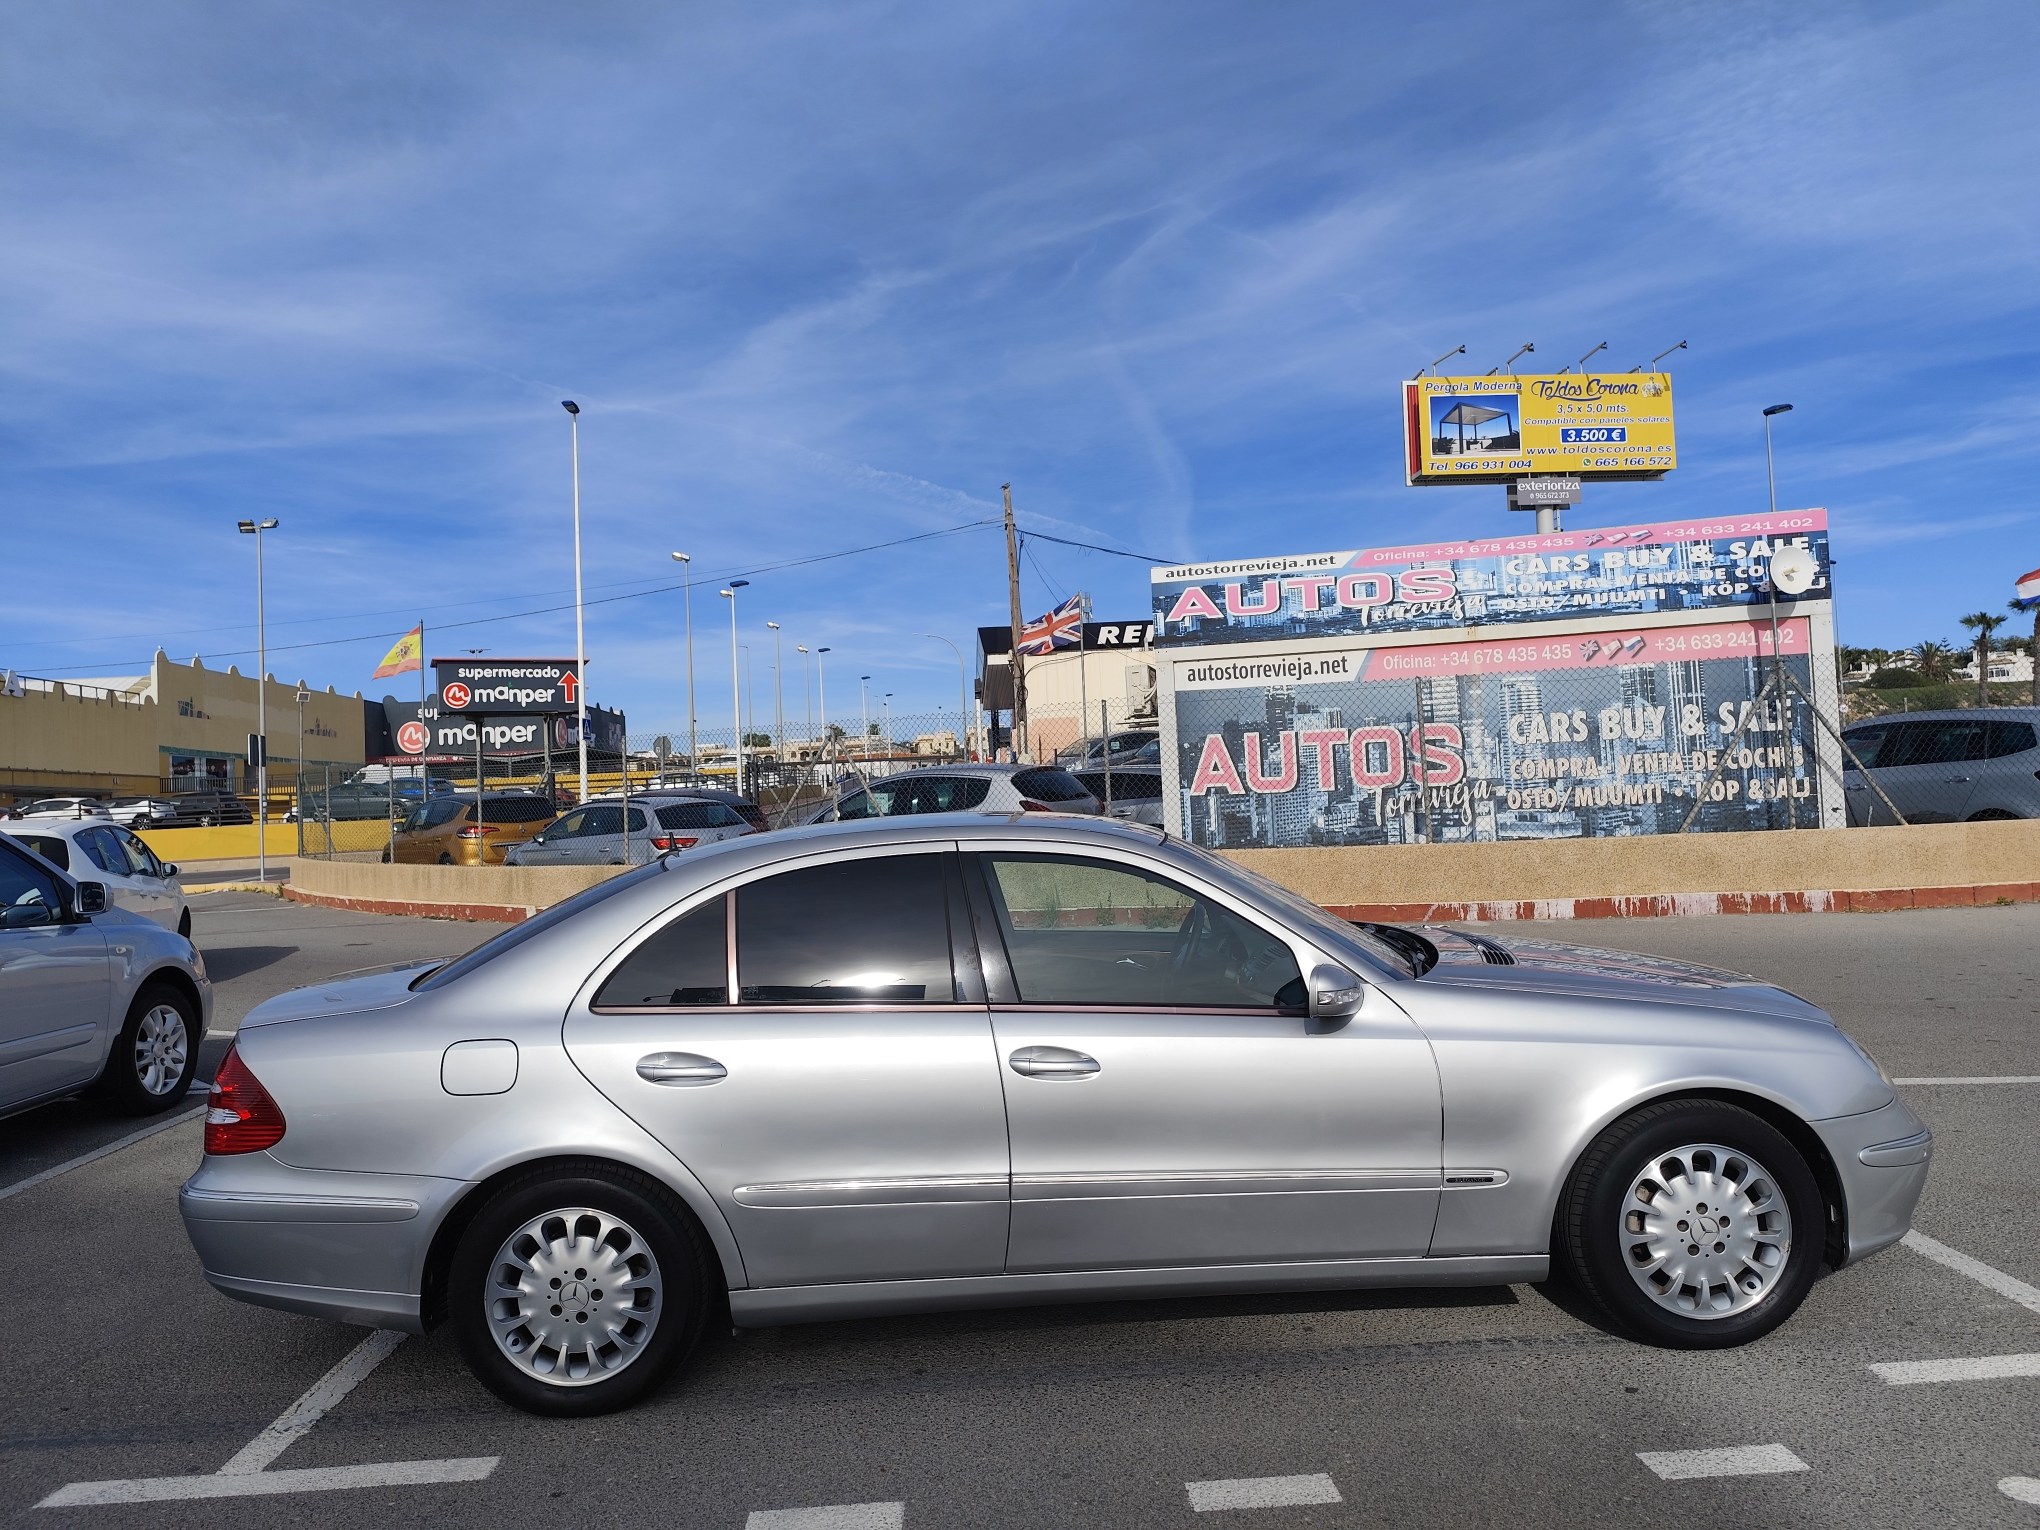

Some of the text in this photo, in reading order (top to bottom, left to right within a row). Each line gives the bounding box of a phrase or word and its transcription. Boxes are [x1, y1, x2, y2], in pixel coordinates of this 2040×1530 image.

[1473, 381, 1522, 390] Moderna
[1531, 378, 1640, 400] Toldos Corona
[1557, 404, 1573, 414] 3,5
[1586, 404, 1602, 414] 5,0
[1606, 404, 1629, 413] mts.
[1525, 417, 1577, 426] Compatible
[1599, 416, 1634, 425] paneles
[1566, 429, 1622, 441] 3.500 €
[1526, 445, 1672, 455] www.toldoscorona.es
[1429, 460, 1532, 471] Tel. 966 931 004
[1595, 457, 1672, 466] 665 166 572
[1518, 480, 1580, 491] exterioriza
[1663, 518, 1813, 537] +34 633 241 402
[1373, 537, 1574, 561] Oficina: +34 678 435 435
[1165, 555, 1337, 579] autostorrevieja.net
[1506, 554, 1590, 576] CARS
[1603, 547, 1674, 569] BUY
[1690, 545, 1714, 562] &
[1619, 570, 1692, 586] VENTA
[1702, 567, 1726, 580] DE
[1165, 569, 1458, 622] AUTOS
[1702, 581, 1749, 597] KÖP
[1655, 636, 1687, 652] +34
[1690, 634, 1723, 649] 633
[1727, 631, 1759, 647] 241
[1383, 644, 1572, 670] Oficina: +34 678 435 435
[458, 665, 560, 681] supermercado
[1187, 655, 1349, 682] autostorrevieja.net
[474, 685, 556, 707] manper
[1509, 711, 1589, 744] CARS
[1600, 705, 1666, 740] BUY
[1681, 704, 1706, 736] &
[438, 724, 538, 749] manper
[1190, 722, 1466, 796] AUTOS
[1619, 752, 1684, 775] VENTA
[1691, 750, 1718, 771] DE
[1367, 777, 1492, 827] Torrvieja
